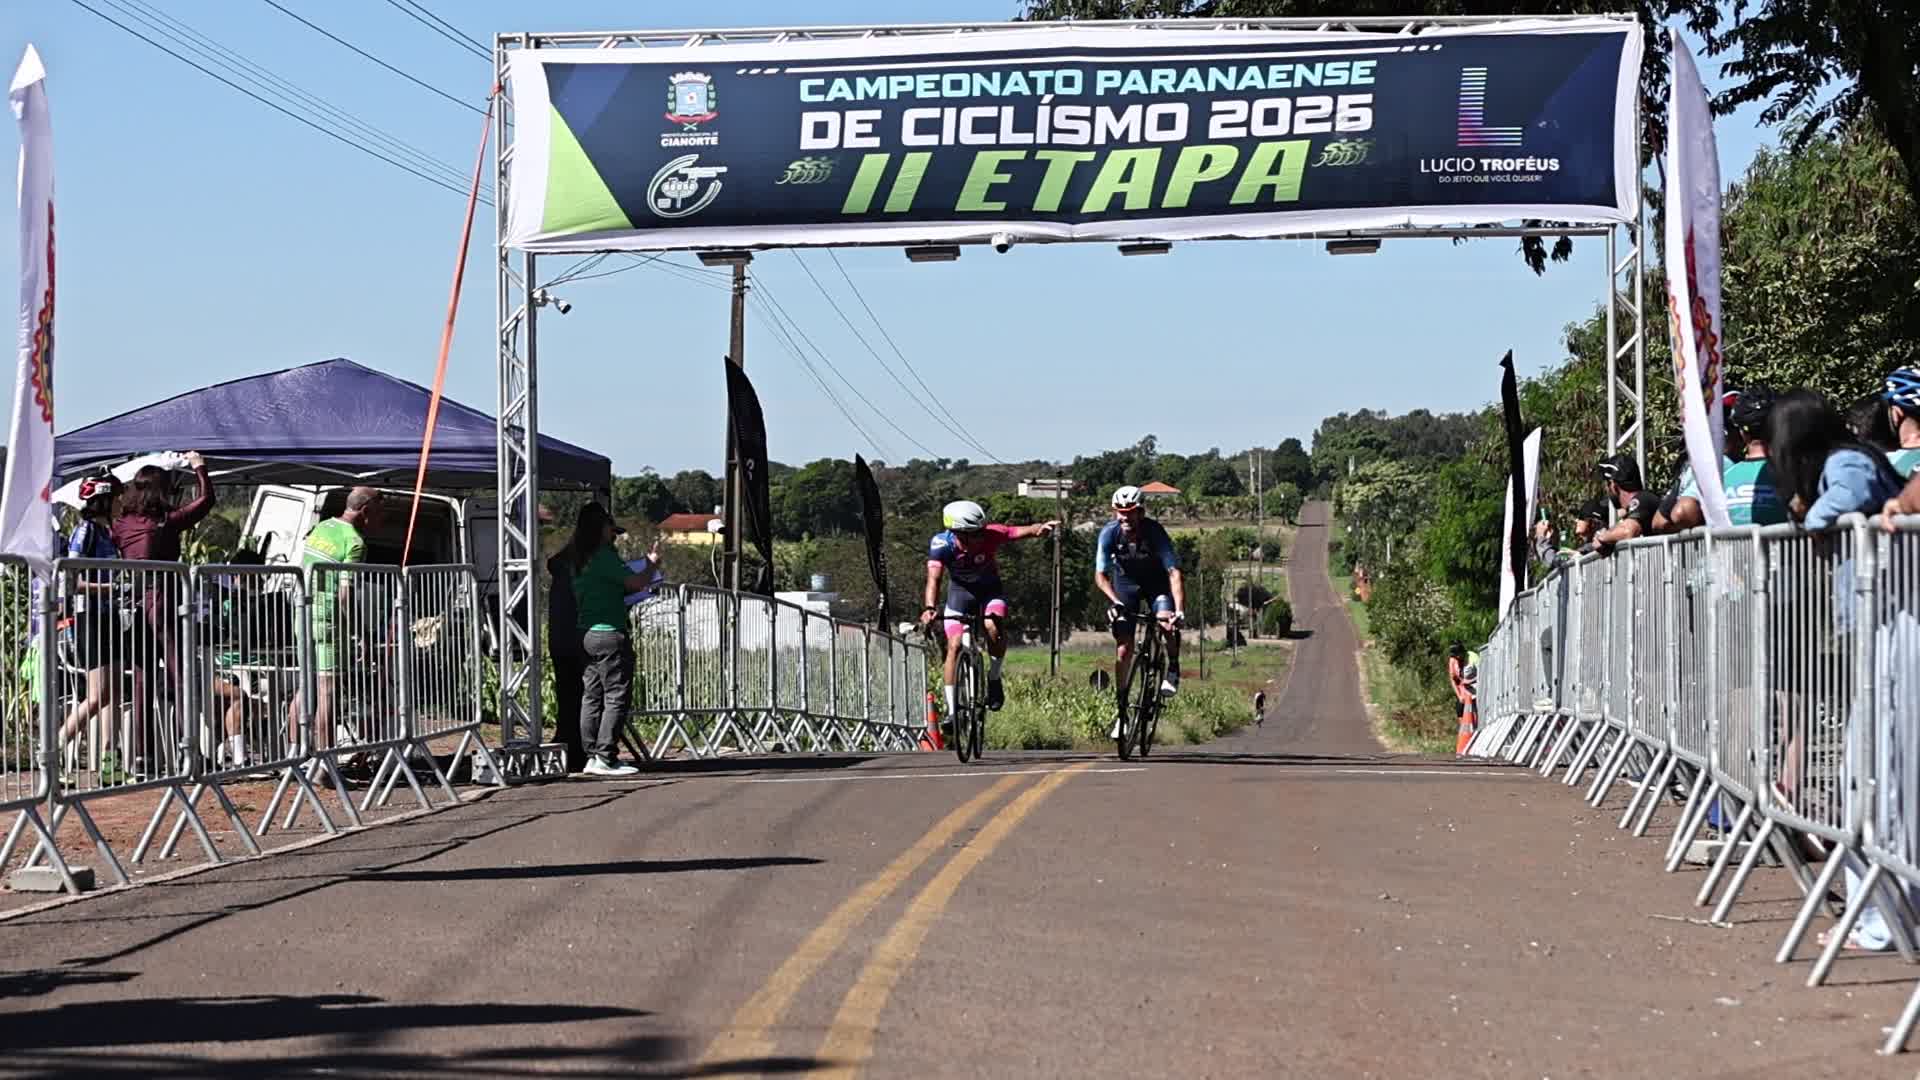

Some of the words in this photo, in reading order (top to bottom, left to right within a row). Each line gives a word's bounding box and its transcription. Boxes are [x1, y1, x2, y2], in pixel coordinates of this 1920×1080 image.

[800, 69, 1084, 103] CAMPEONATO
[1095, 60, 1378, 96] PARANAENSE
[660, 136, 719, 147] CIANORTE
[799, 109, 883, 150] DE
[901, 93, 1190, 146] CICLÍSMO
[840, 151, 934, 215] II
[954, 139, 1312, 214] ETAPA
[1420, 157, 1476, 173] LUCIO
[1480, 155, 1560, 172] TROFÉUS
